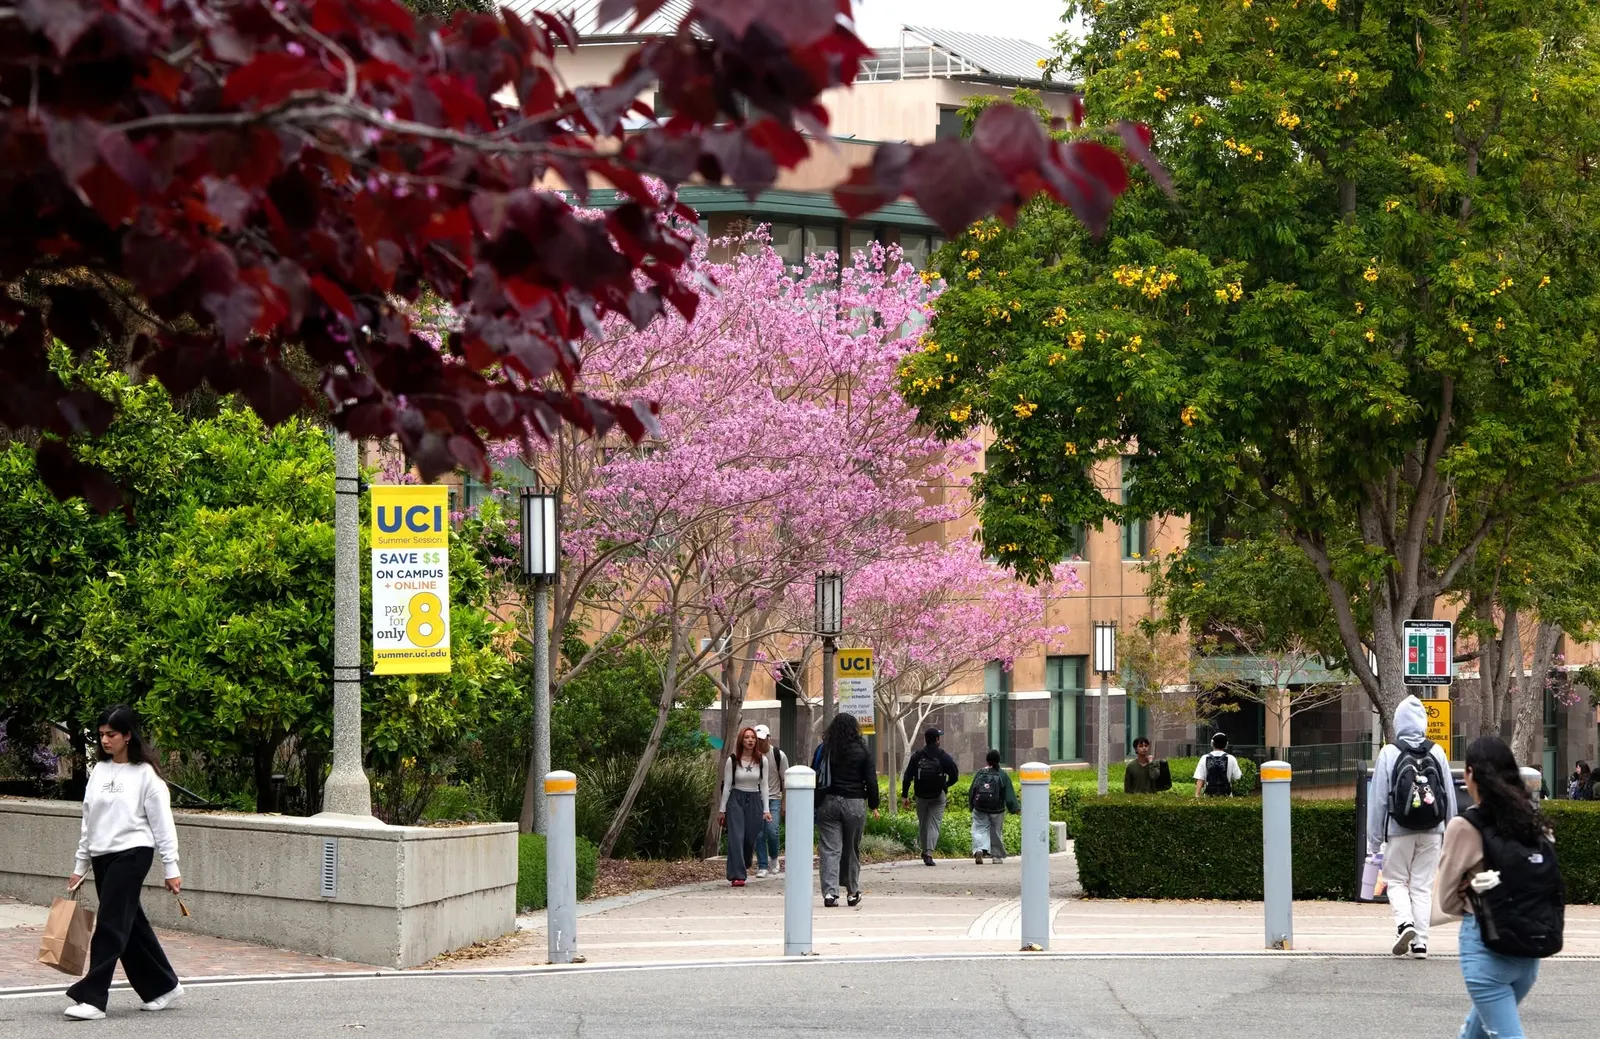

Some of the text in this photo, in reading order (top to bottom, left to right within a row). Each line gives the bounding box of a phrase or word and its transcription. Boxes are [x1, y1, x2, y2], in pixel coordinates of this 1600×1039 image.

[377, 505, 442, 533] UCI
[378, 536, 442, 544] Summer Session
[380, 552, 440, 564] SAVE $$
[376, 569, 443, 579] ON CAMPUS
[394, 581, 437, 590] ONLINE
[385, 605, 405, 616] pay
[389, 615, 405, 626] for
[406, 591, 446, 648] 8
[376, 627, 405, 641] only
[377, 649, 447, 659] summer.uci.edu
[840, 657, 870, 671] UCI
